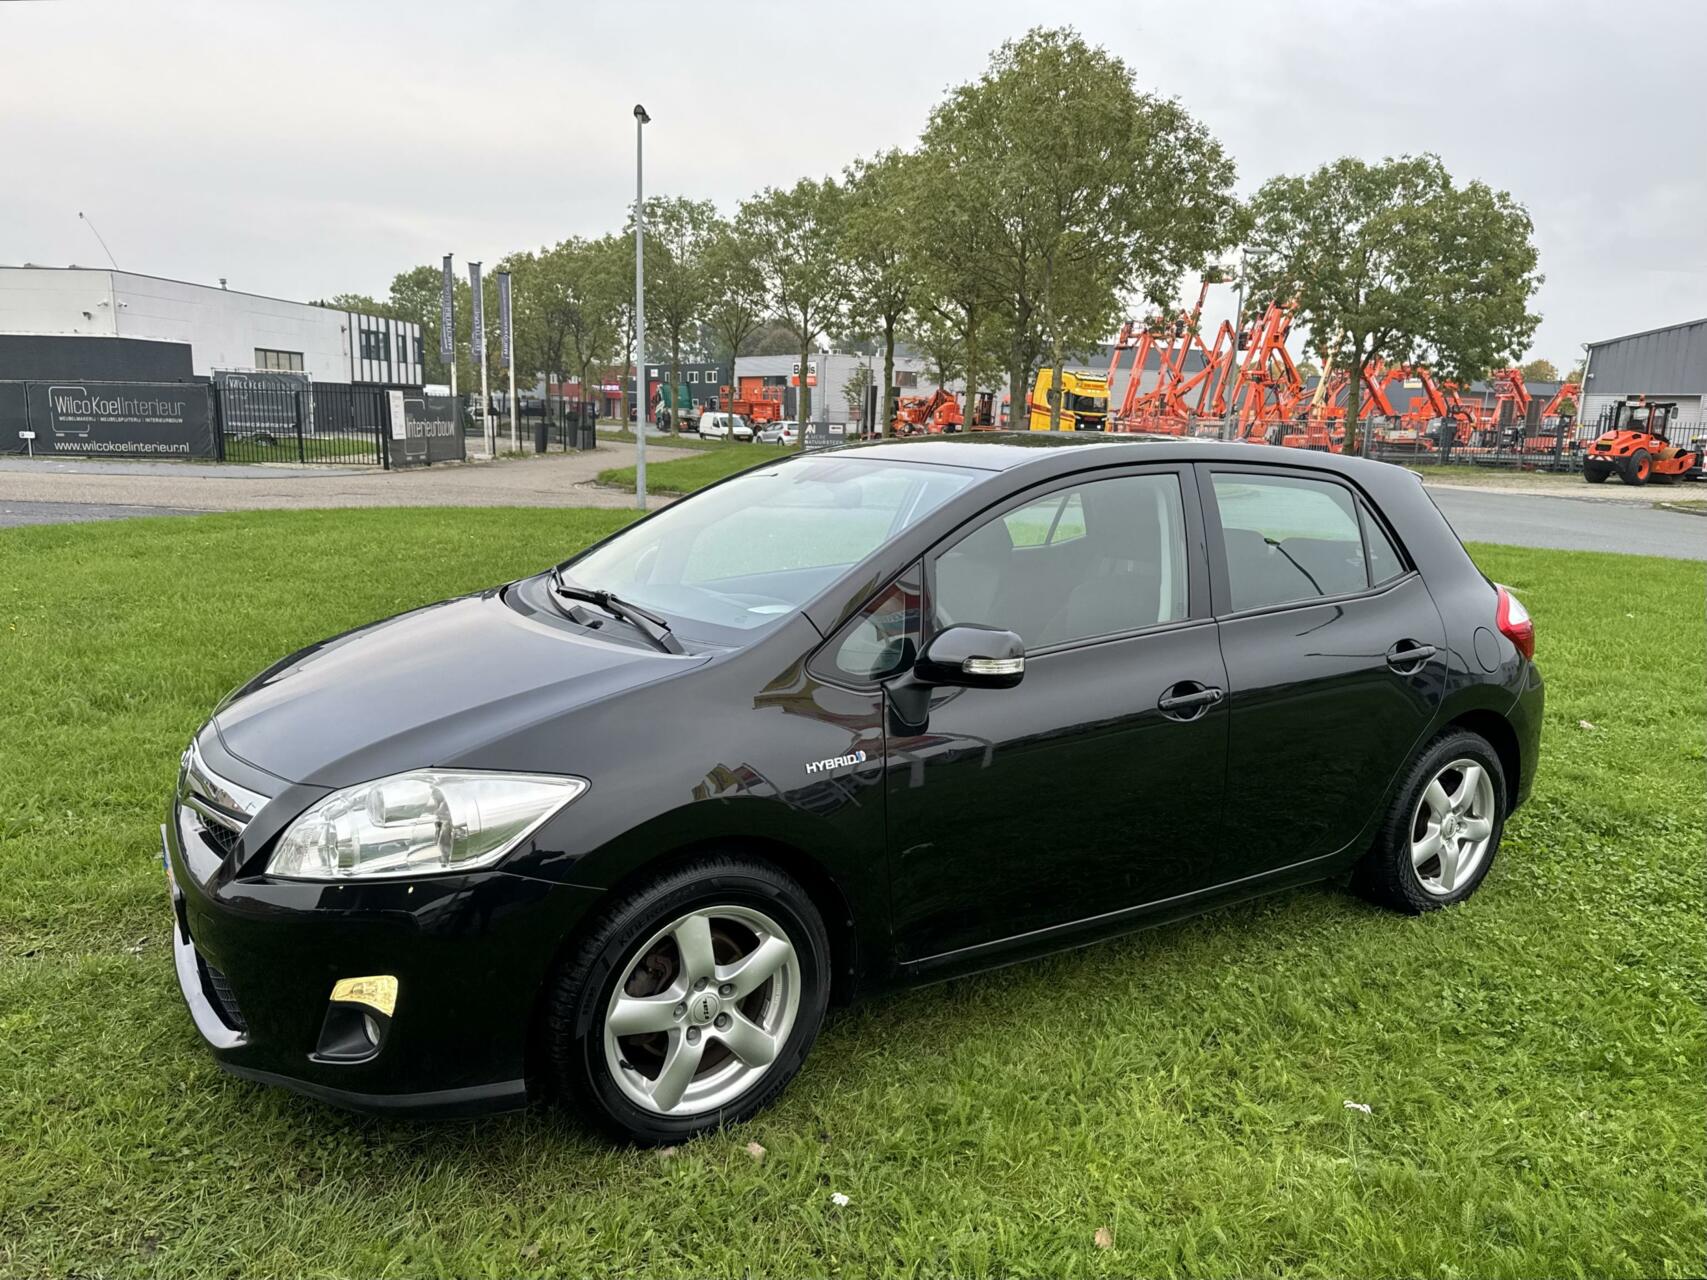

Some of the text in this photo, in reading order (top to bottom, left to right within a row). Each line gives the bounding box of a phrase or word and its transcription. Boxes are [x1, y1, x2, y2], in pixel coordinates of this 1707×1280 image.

[793, 363, 816, 375] Bls
[54, 440, 190, 453] www.wilcokoelinterieur.nl
[805, 754, 860, 774] HYBRID
